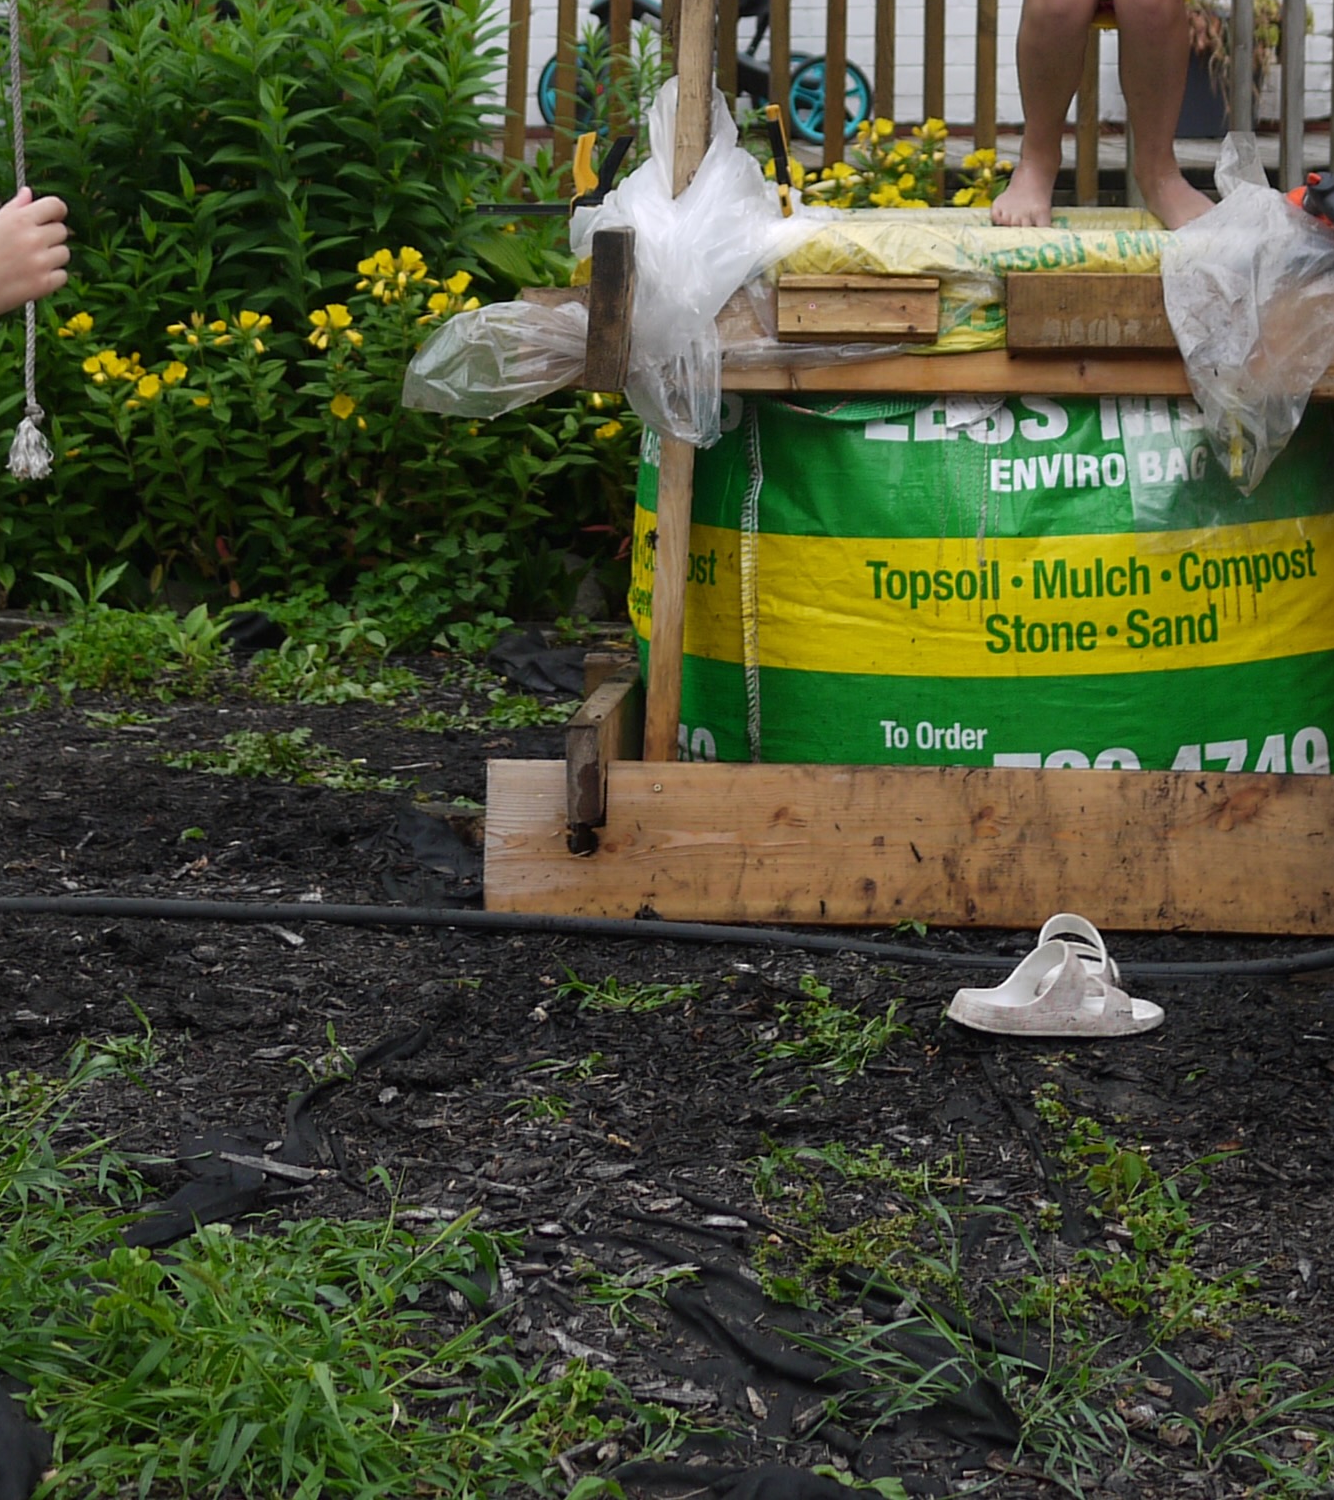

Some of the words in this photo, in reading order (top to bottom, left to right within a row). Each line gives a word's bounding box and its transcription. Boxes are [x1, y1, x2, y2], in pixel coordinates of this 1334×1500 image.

[990, 452, 1127, 493] ENVIRO
[1138, 445, 1208, 485] BAG
[866, 560, 999, 609] Topsoil
[1033, 557, 1151, 599] Mulch
[1178, 540, 1318, 593] Compost
[986, 613, 1098, 654] Stone
[1126, 603, 1218, 649] Sand
[880, 720, 909, 749] To
[916, 721, 988, 750] Order
